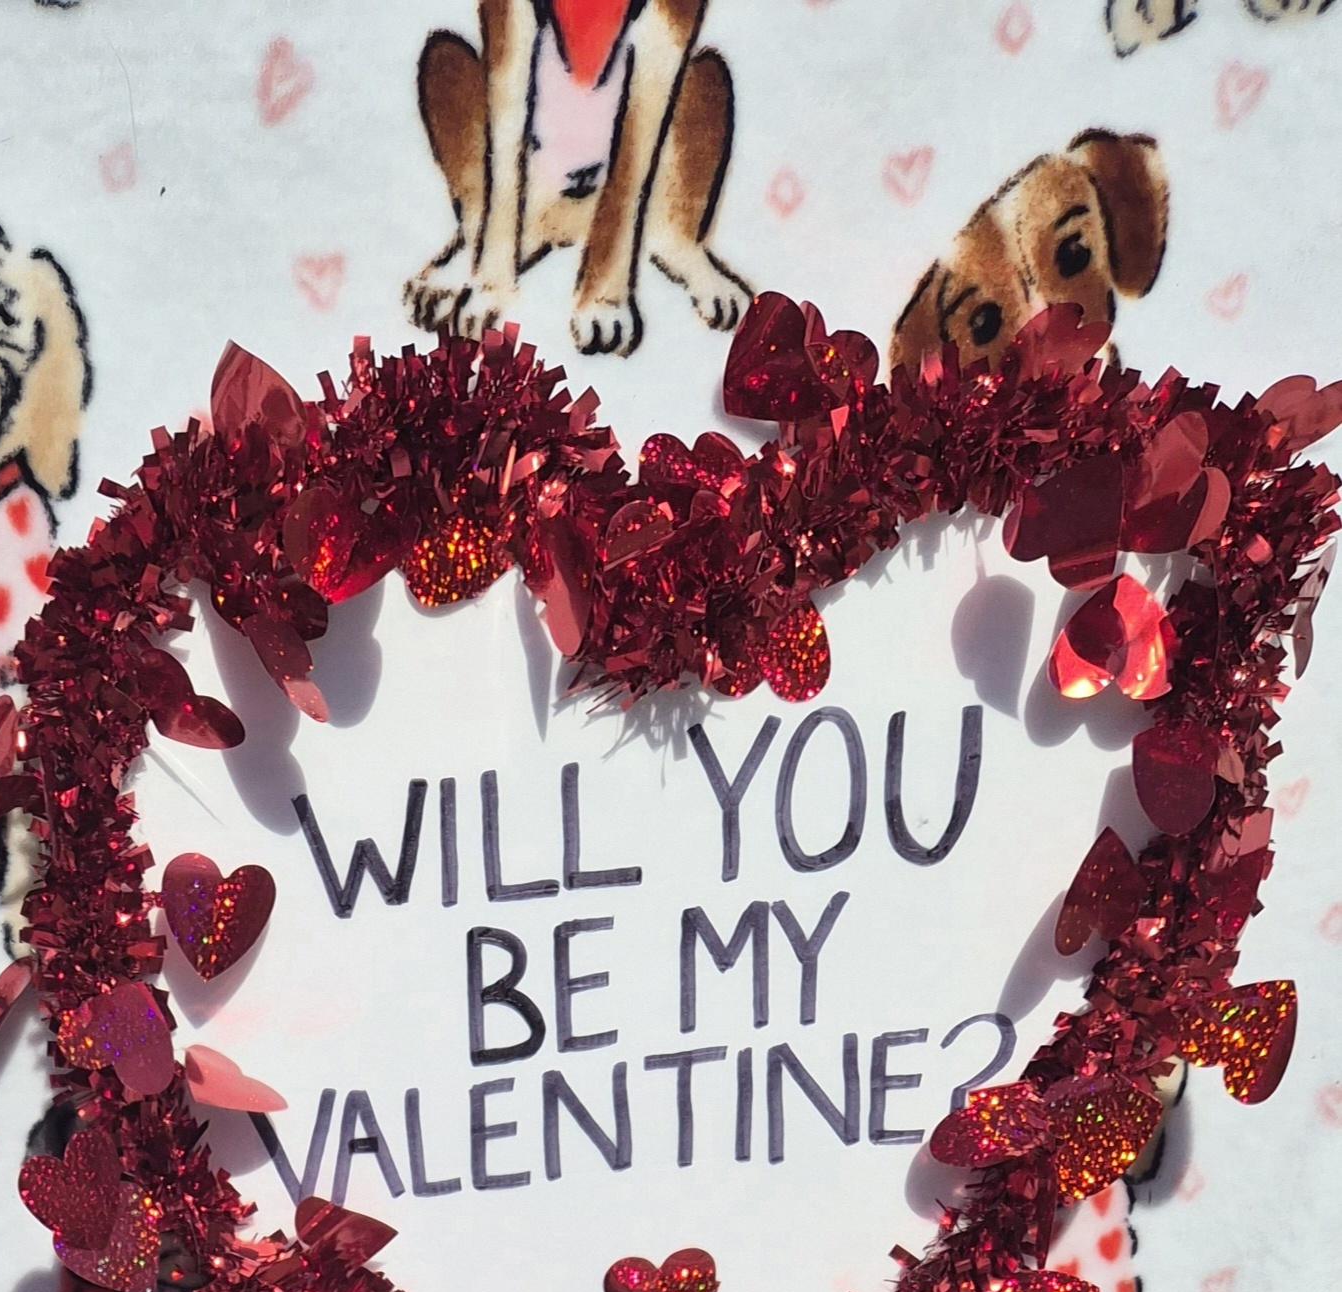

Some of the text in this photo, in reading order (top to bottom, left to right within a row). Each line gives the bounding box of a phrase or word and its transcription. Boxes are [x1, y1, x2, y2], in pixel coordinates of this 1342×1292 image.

[291, 705, 984, 919] WILL YOU
[466, 890, 851, 1067] BE MY
[247, 1013, 1018, 1208] VALENTINE?
